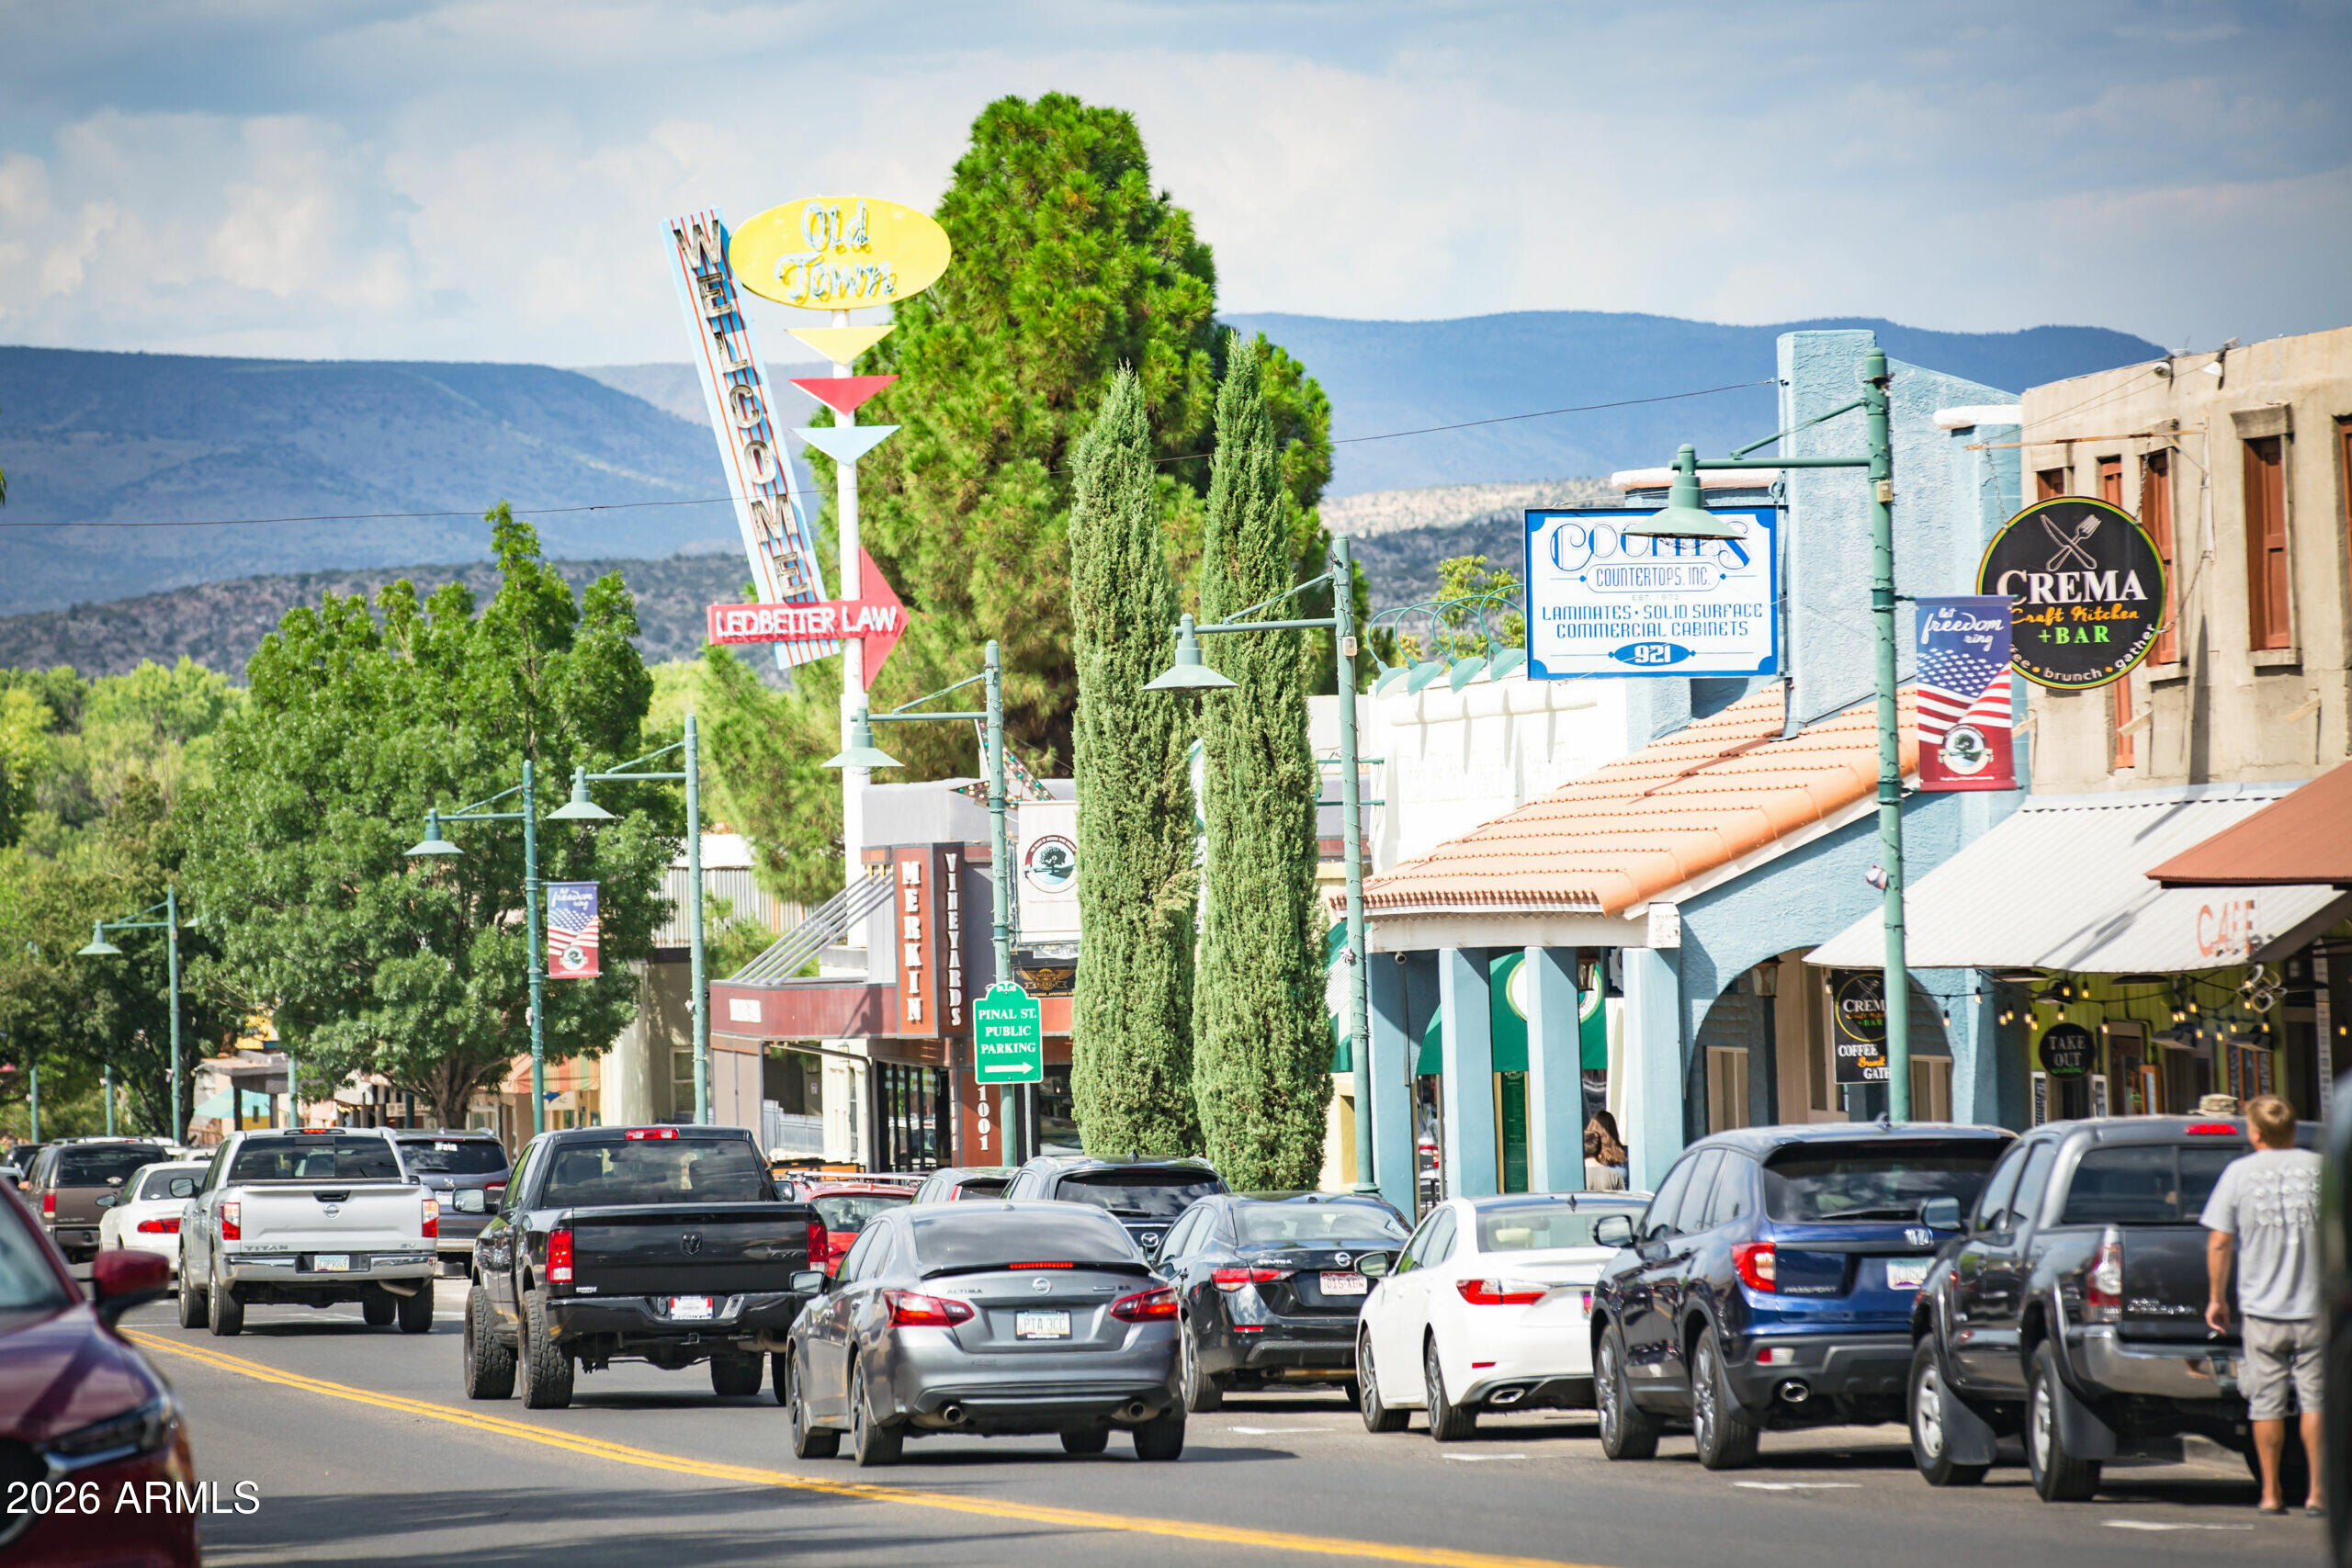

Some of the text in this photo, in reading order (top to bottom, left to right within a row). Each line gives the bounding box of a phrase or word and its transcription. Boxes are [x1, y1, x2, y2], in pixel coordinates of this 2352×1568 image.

[801, 199, 871, 254] Old
[775, 250, 899, 301] Town
[673, 218, 808, 600] WELCOME
[1689, 566, 1712, 586] INC.
[1996, 569, 2149, 606] CREMA
[716, 605, 897, 637] LEDBETTER LAW
[1542, 602, 1763, 621] LAMINATES SOLID SURFACE
[1938, 607, 1957, 619] let
[2010, 603, 2140, 626] Craft Kitchen
[1556, 620, 1748, 638] COMMERCIAL CABINETS
[1920, 612, 2005, 645] freedom
[1963, 634, 1994, 652] ring
[2043, 667, 2103, 682] brunch
[2114, 623, 2156, 671] gather
[1634, 645, 1671, 663] 921
[901, 861, 922, 1021] MERKIN
[944, 853, 962, 1027] VINEYARDS
[978, 1008, 1037, 1021] PINAL ST.
[1842, 998, 1886, 1013] CREM
[985, 1025, 1032, 1037] PUBLIC
[980, 1042, 1036, 1055] PARKING
[1838, 1043, 1878, 1057] COFFEE
[2048, 1035, 2086, 1050] TAKE
[2053, 1052, 2082, 1066] OUT
[978, 1085, 991, 1151] 1001
